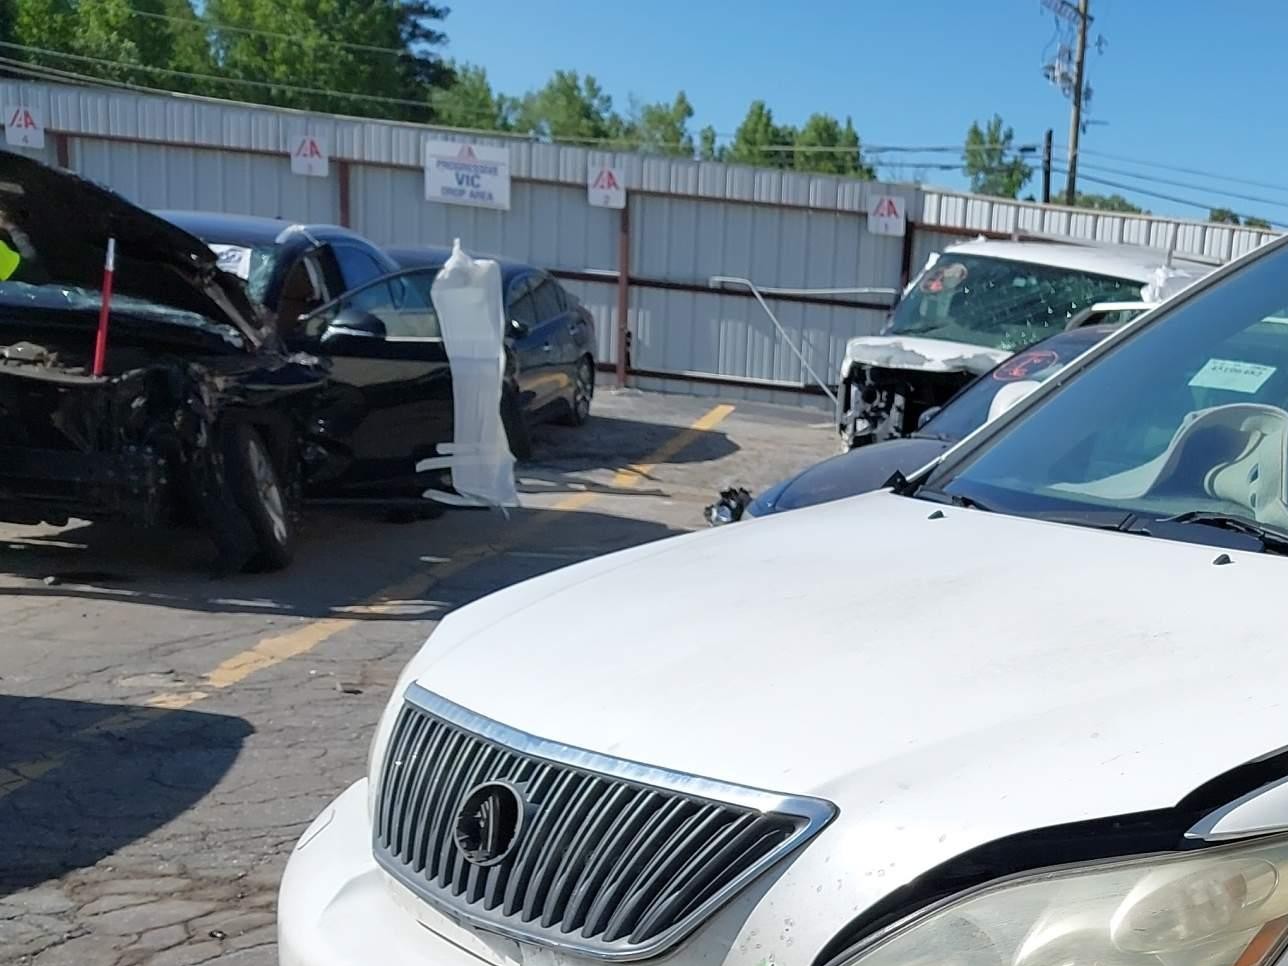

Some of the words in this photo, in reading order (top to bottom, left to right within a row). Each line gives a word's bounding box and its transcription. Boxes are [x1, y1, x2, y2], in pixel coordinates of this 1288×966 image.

[455, 172, 481, 188] VIC
[441, 187, 467, 198] DROP
[468, 190, 494, 202] AREA
